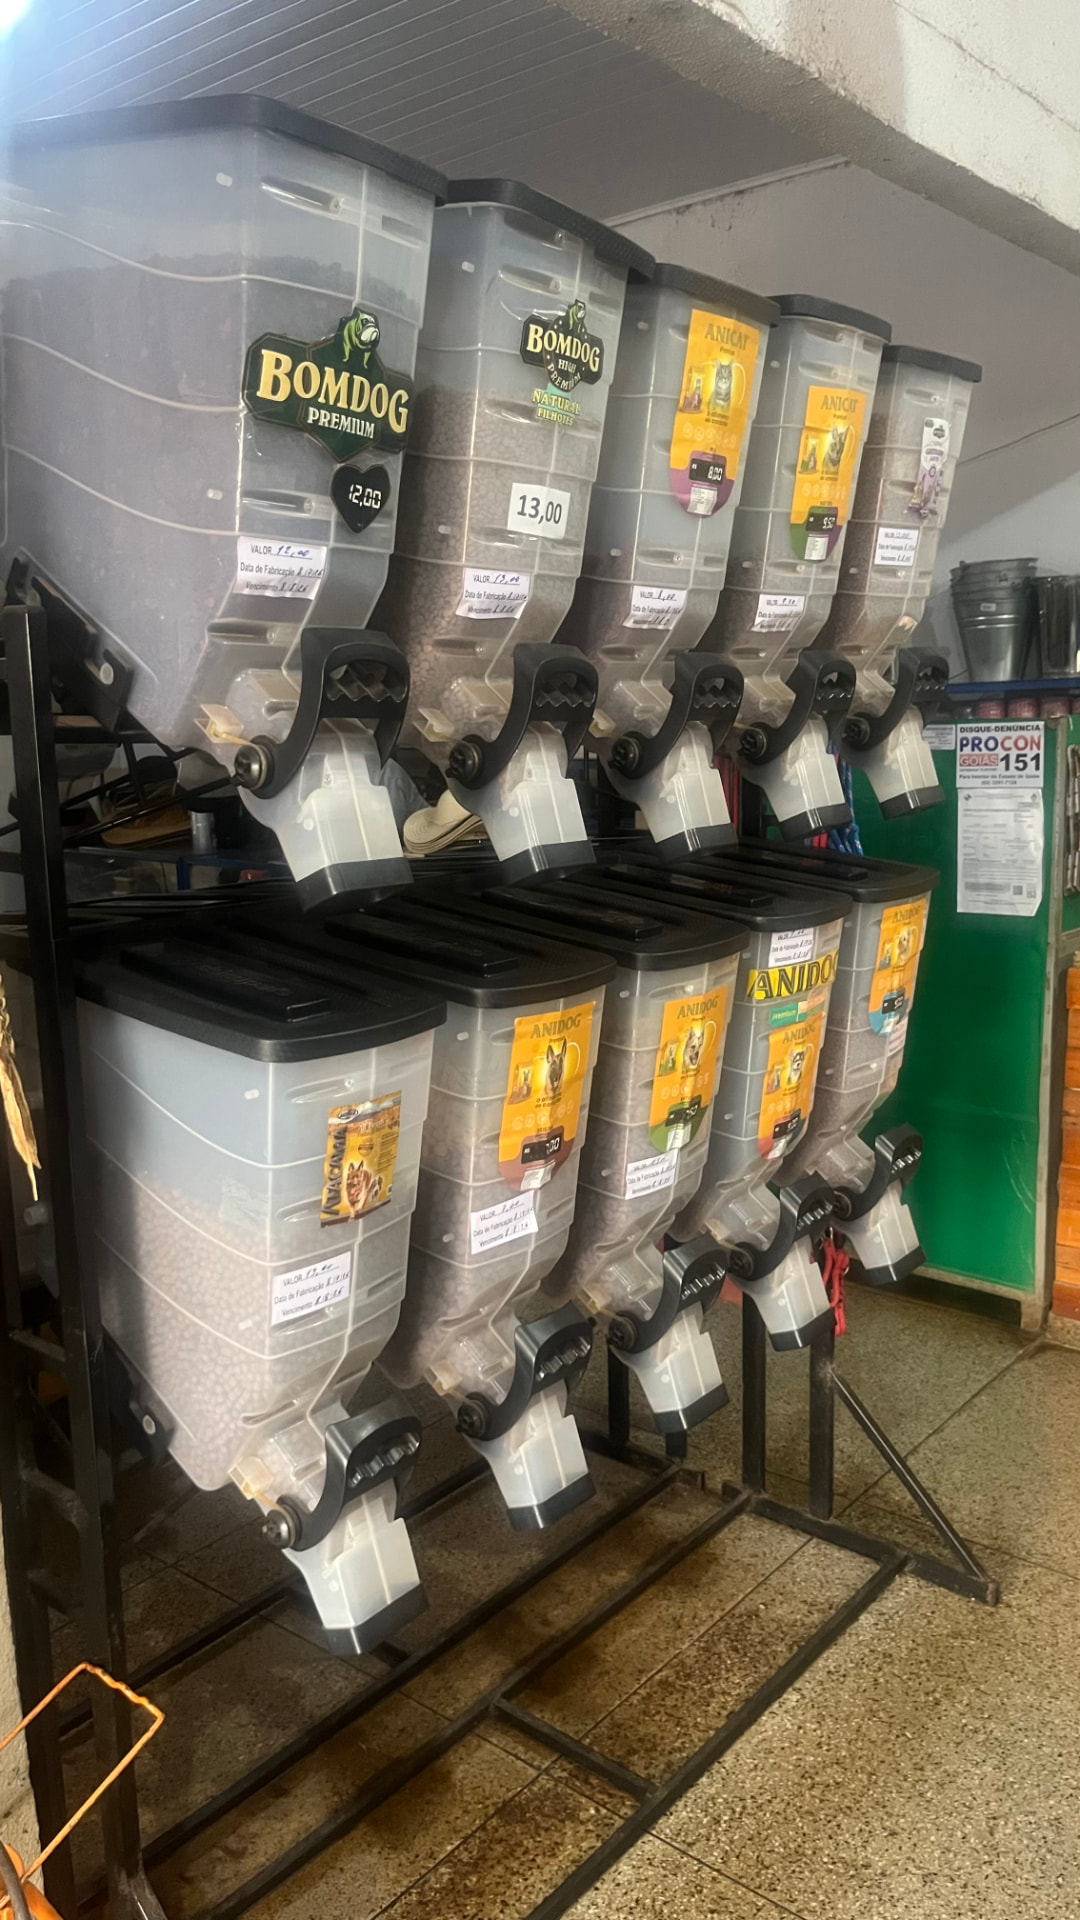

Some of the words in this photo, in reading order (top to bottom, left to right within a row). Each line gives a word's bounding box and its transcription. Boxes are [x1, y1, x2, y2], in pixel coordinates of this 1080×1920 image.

[704, 323, 750, 351] ANICAT
[526, 324, 601, 372] BOMDOG
[547, 363, 581, 390] PREMIUM
[557, 359, 578, 373] HIGH
[256, 348, 409, 434] BOMDOG
[531, 389, 580, 415] NATURAL
[307, 407, 375, 439] PREMIUM
[537, 407, 574, 426] FILHOTES
[348, 484, 381, 510] 12,00
[516, 494, 563, 525] 13,00
[250, 544, 272, 555] VALOR
[240, 561, 254, 573] Data
[255, 563, 263, 573] de
[264, 564, 295, 577] Fabricação
[473, 574, 491, 583] VALOR
[959, 724, 1041, 734] DISQUE-DENÚNCIA
[959, 735, 1041, 752] PROCON
[960, 755, 998, 766] GOIÁS
[1000, 753, 1040, 771] 151
[677, 995, 719, 1019] ANIDOG
[529, 1013, 583, 1039] ANIDOG
[782, 1023, 816, 1044] ANIDOG
[321, 1126, 348, 1216] ATACAMA
[479, 1210, 496, 1222] VALOR
[282, 1274, 303, 1287] VALOR
[274, 1296, 288, 1304] Data
[287, 1292, 295, 1300] de
[296, 1283, 325, 1297] Fabricação
[282, 1301, 314, 1316] Vencimento
